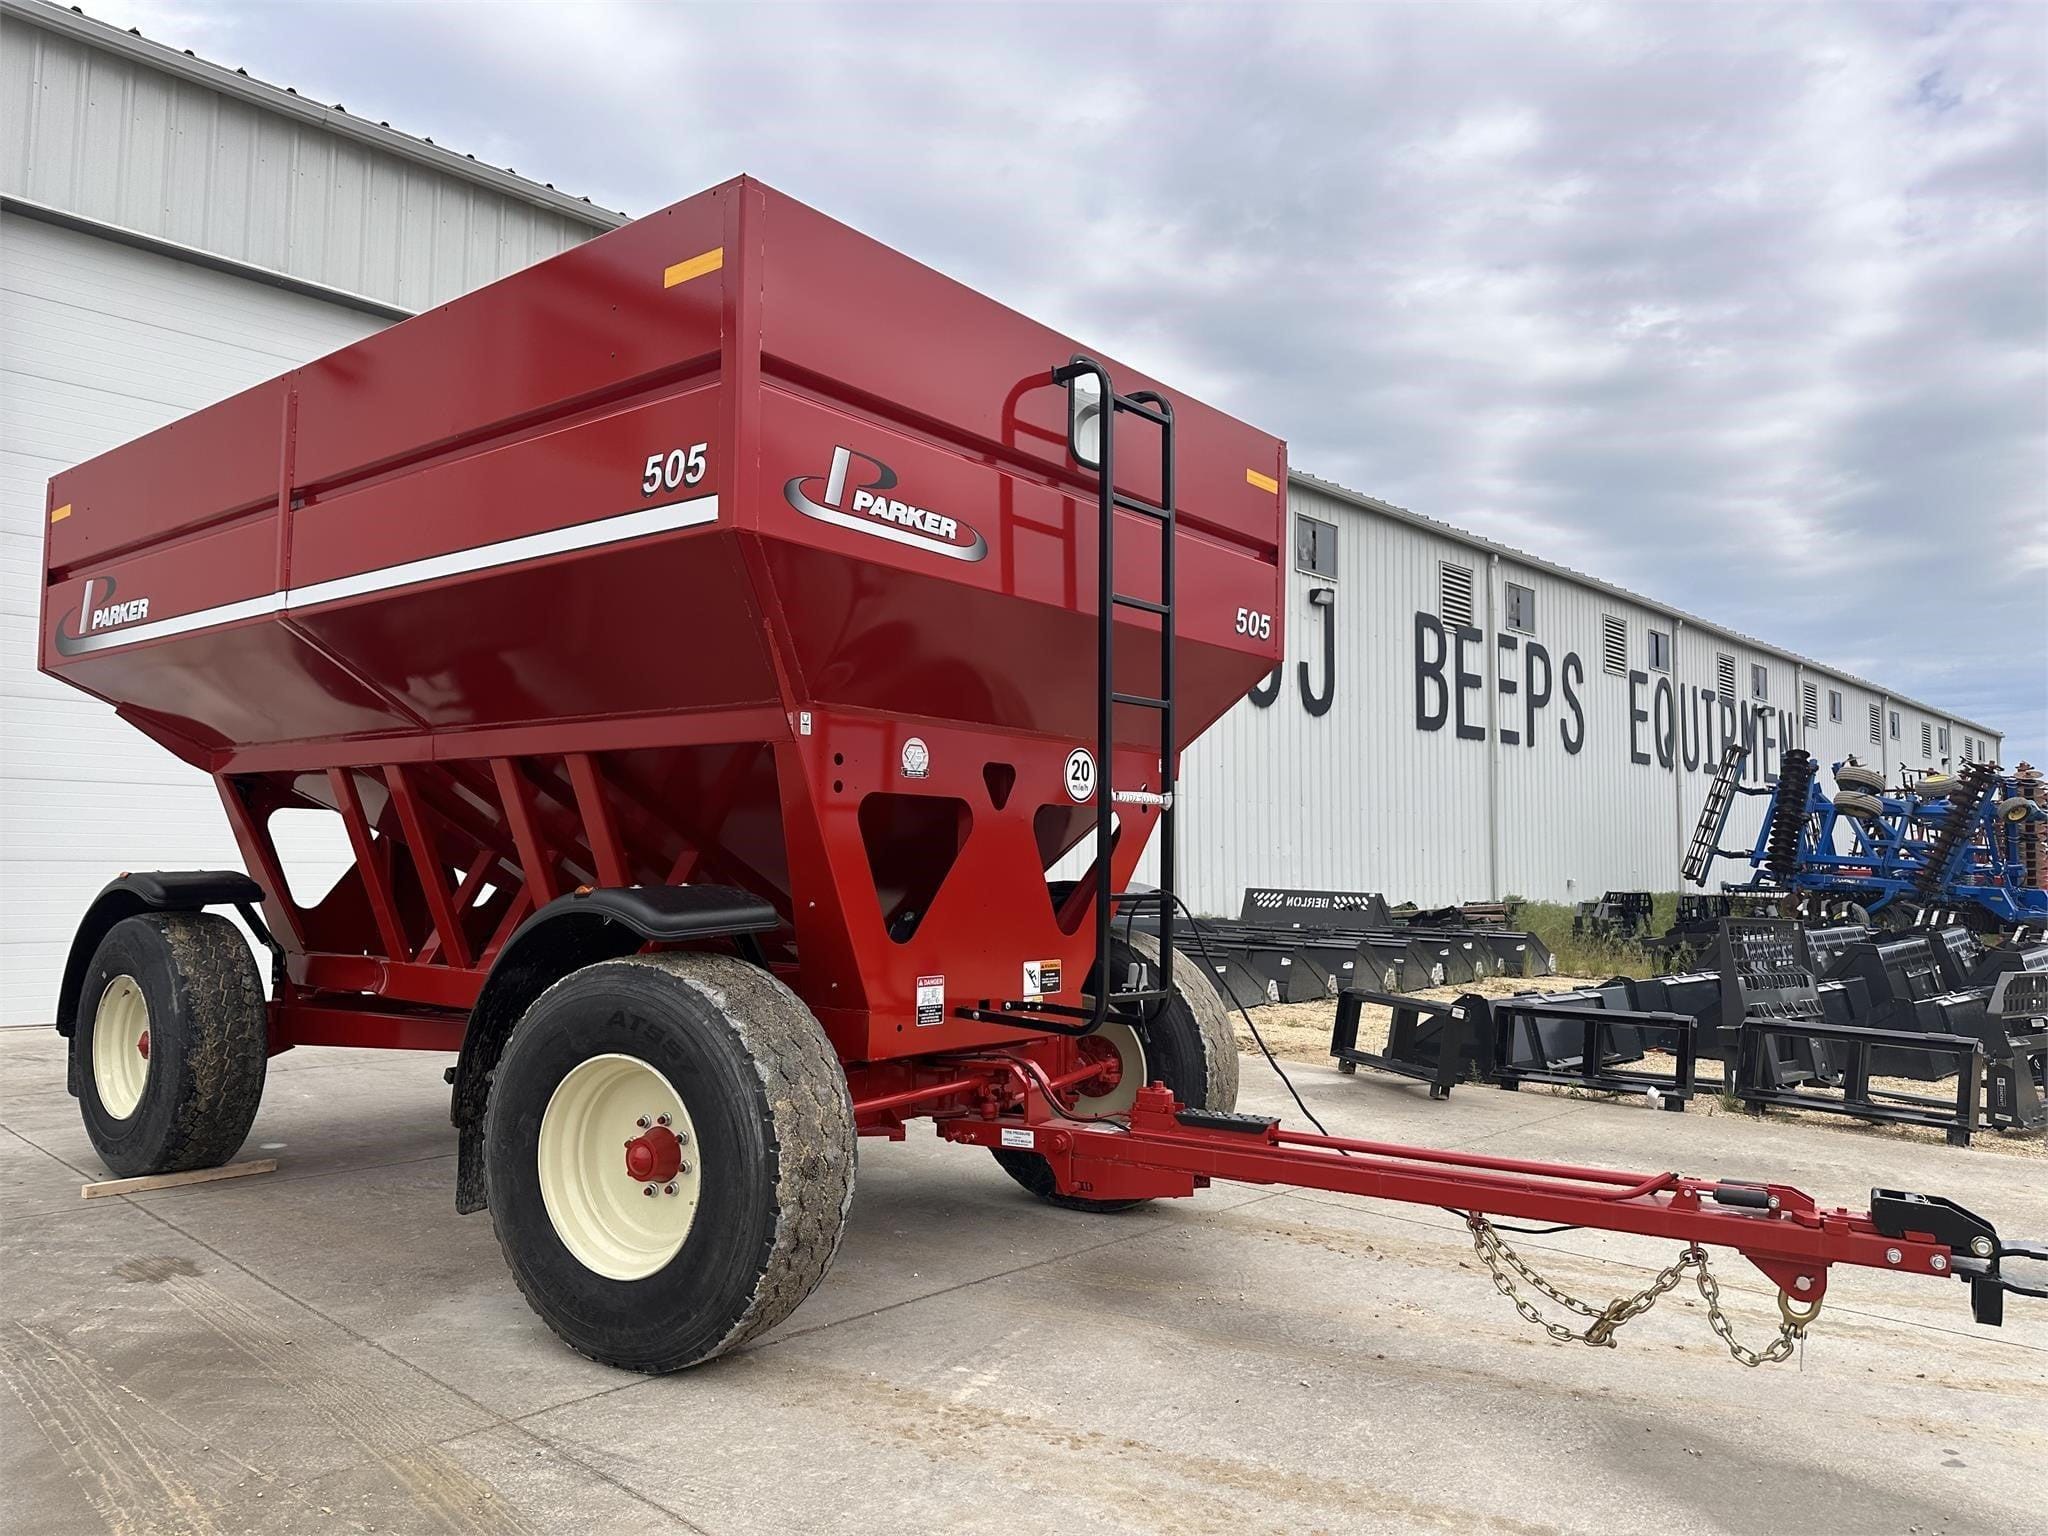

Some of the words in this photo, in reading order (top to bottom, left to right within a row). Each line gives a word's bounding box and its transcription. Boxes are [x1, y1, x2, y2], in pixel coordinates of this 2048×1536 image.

[642, 443, 708, 497] 505
[852, 488, 959, 541] PARKER
[91, 597, 149, 630] PARKER
[1236, 607, 1271, 640] 505
[1415, 611, 1586, 755] BEEPS
[1071, 759, 1090, 782] 20
